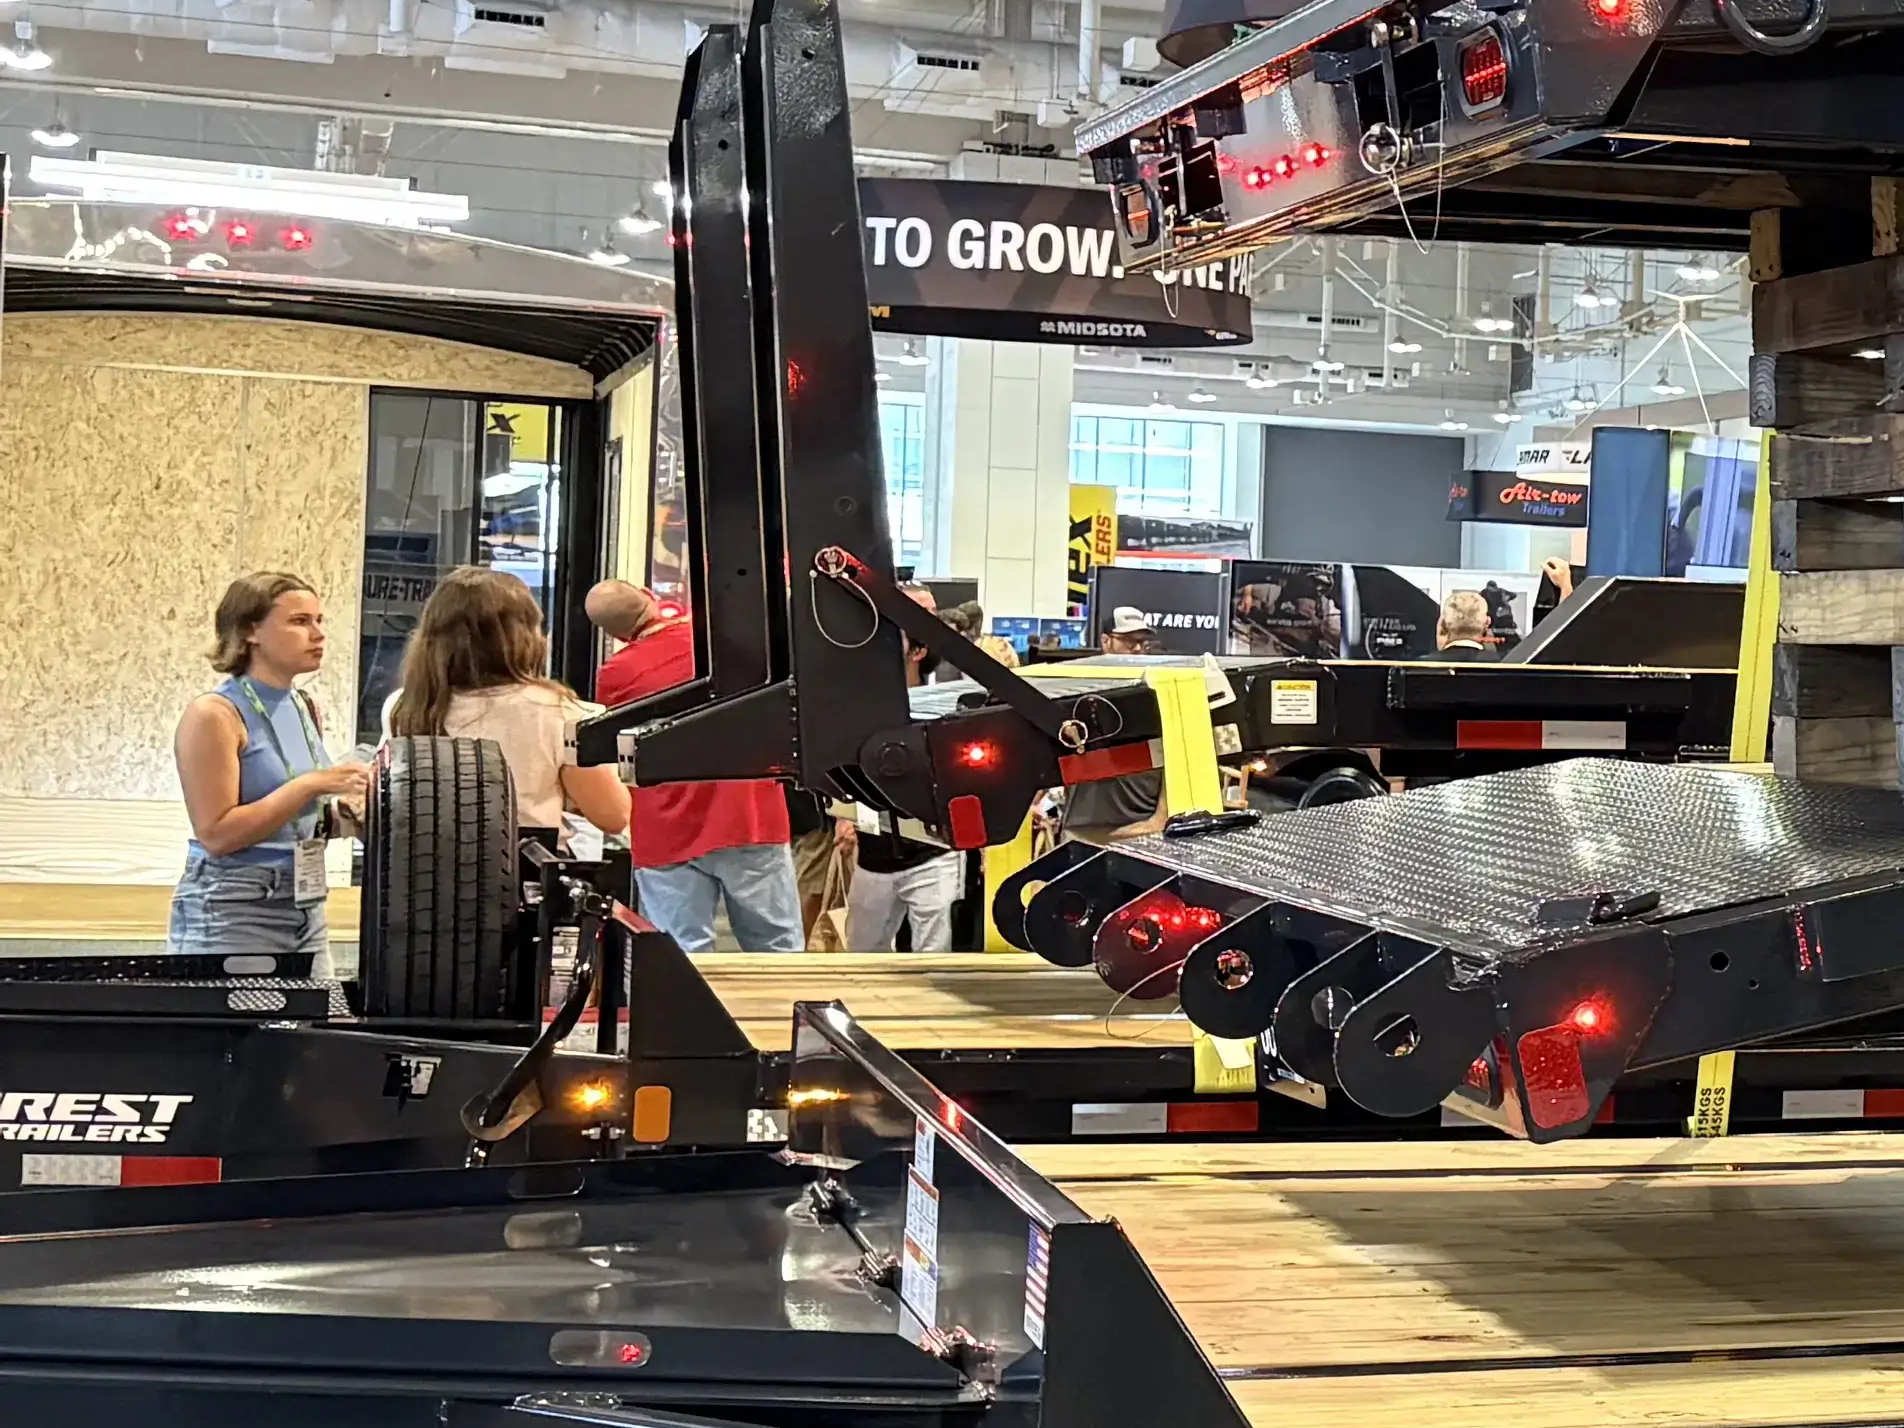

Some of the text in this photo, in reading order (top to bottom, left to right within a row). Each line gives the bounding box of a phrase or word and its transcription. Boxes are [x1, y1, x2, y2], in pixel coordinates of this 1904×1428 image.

[865, 216, 932, 268] TO
[947, 218, 1126, 279] GROW.
[1057, 321, 1148, 338] MIDSOTA
[1522, 501, 1566, 517] Trailers
[1162, 613, 1193, 628] ARE
[0, 1092, 194, 1123] REST
